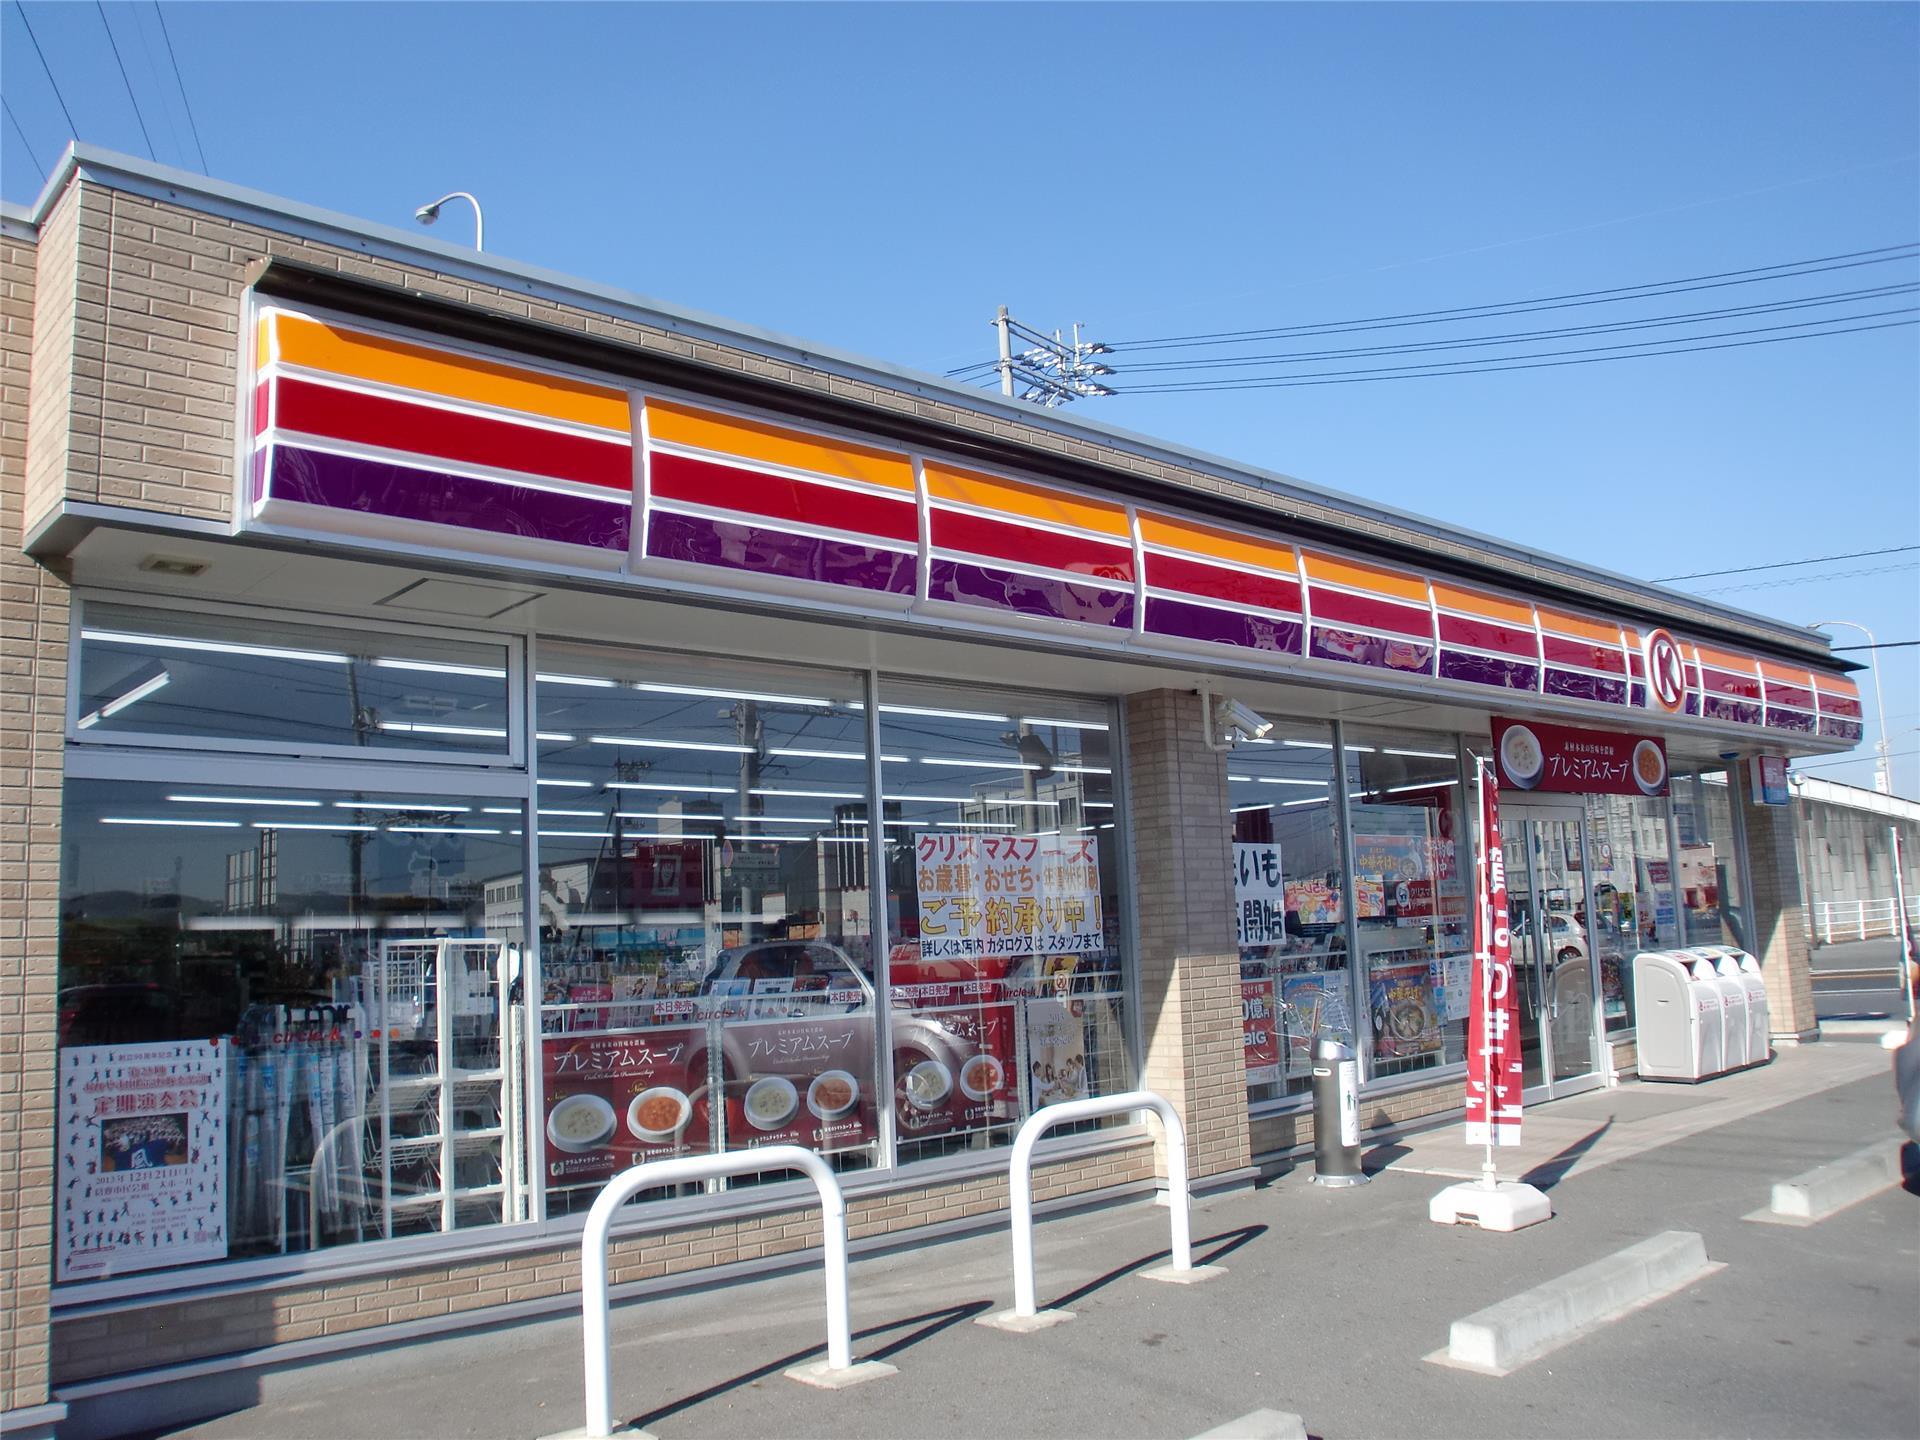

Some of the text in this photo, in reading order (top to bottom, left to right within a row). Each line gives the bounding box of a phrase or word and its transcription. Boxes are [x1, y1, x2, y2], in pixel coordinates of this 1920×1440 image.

[1656, 645, 1680, 703] K
[1549, 753, 1631, 783] プレミアムスープ
[917, 835, 1095, 864] クリスマスフーズ
[1233, 849, 1281, 887] いも
[1236, 900, 1283, 943] 開始
[655, 1001, 693, 1014] 本日発売
[831, 991, 862, 1002] 本日発売
[748, 1030, 855, 1058] プレミアムスープ
[1243, 1031, 1267, 1046] BIG
[553, 1042, 684, 1074] プレミアムスープ
